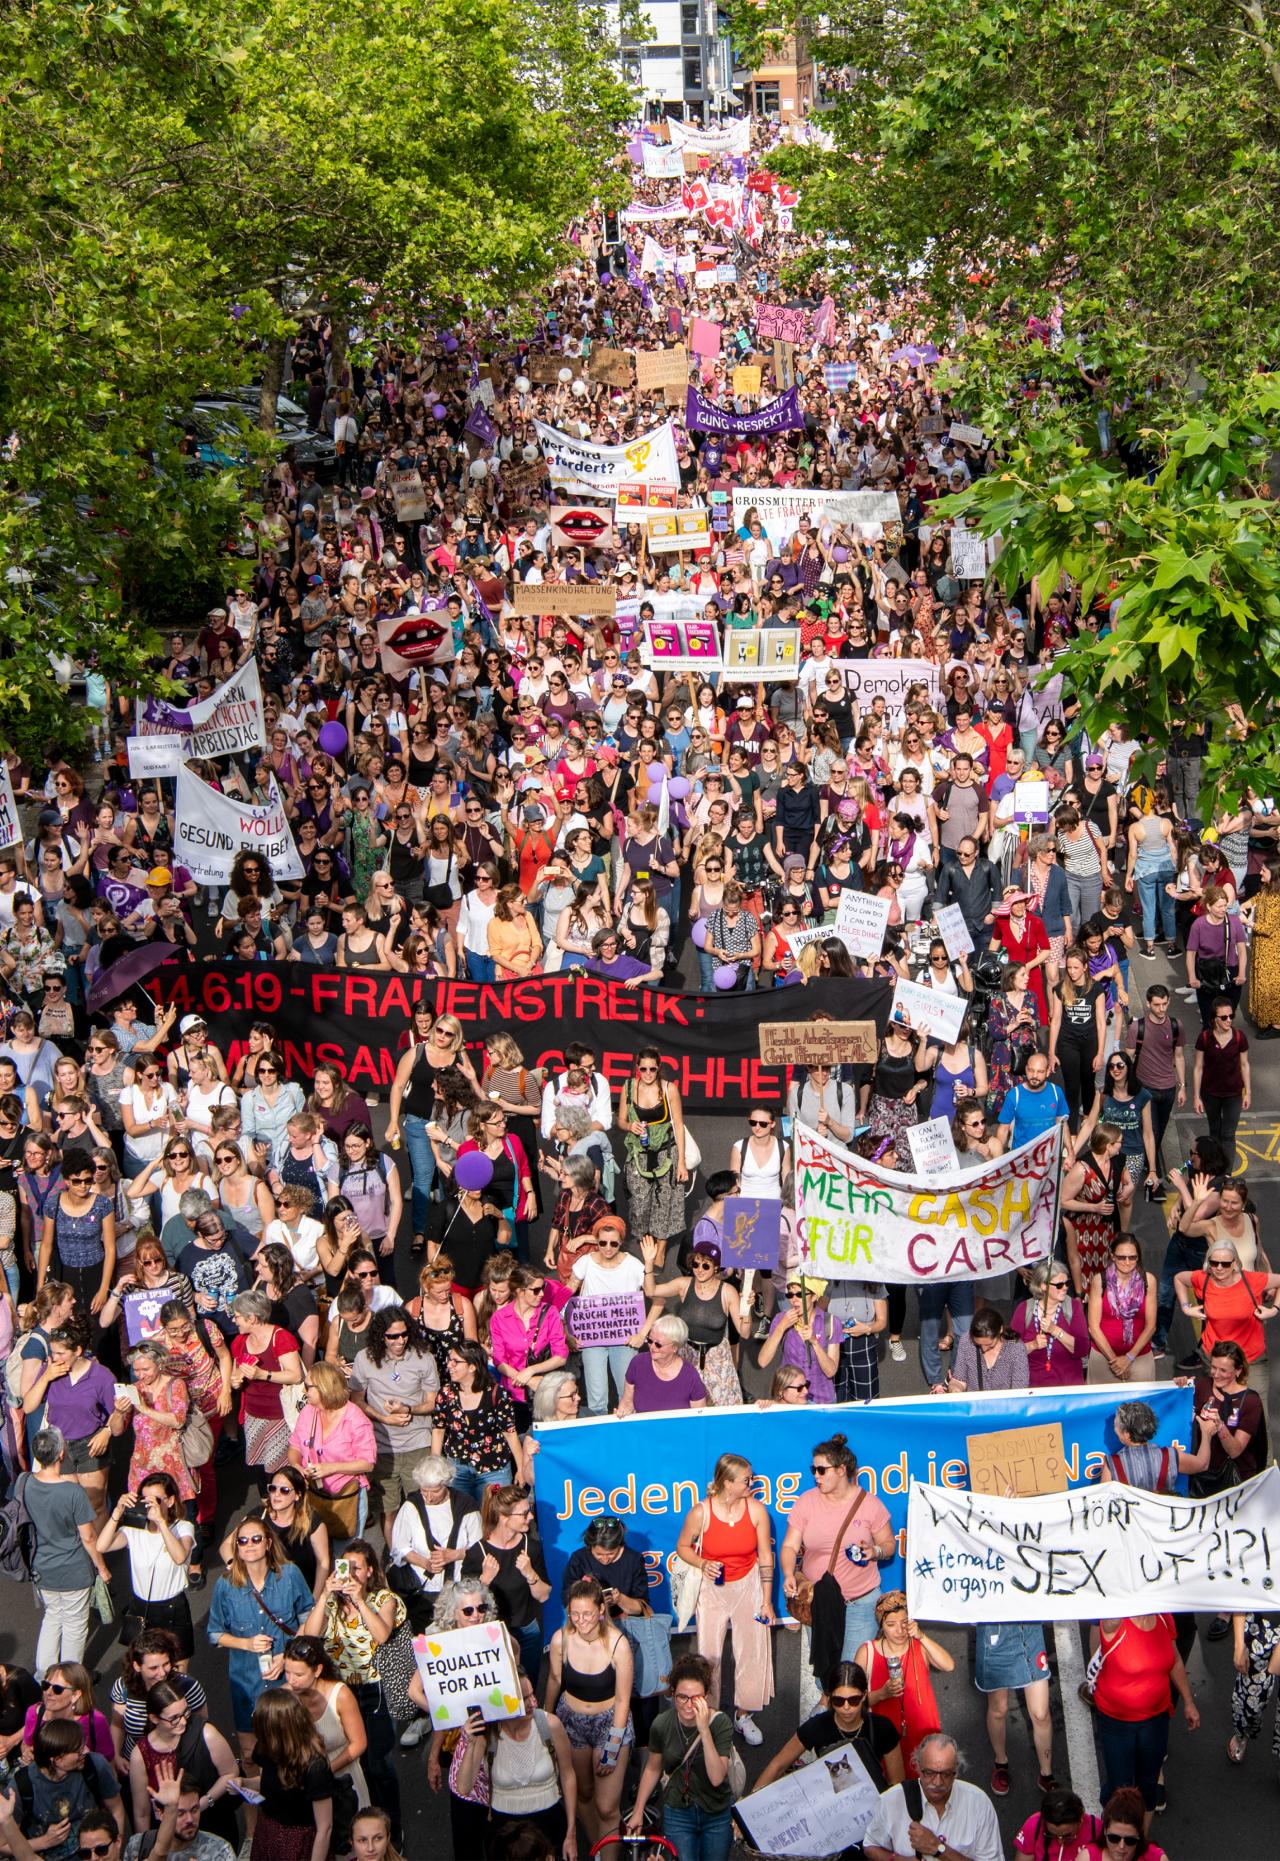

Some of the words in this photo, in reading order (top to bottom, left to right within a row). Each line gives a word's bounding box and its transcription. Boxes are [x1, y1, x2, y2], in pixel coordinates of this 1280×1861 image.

[696, 411, 730, 430] IGUNG
[736, 411, 784, 432] RESPEKT
[568, 447, 601, 461] wird
[516, 585, 612, 595] MASSENKINDHALTUNG
[845, 669, 941, 694] Demokrat
[193, 722, 258, 757] ARBEITSTAG
[180, 822, 234, 851] GESUND
[844, 893, 885, 909] ANYTHING
[849, 917, 865, 925] CAN
[866, 920, 878, 928] DO
[144, 971, 283, 1013] 14.6.19
[908, 1180, 1030, 1236] CASH
[806, 1216, 875, 1266] FÜR
[907, 1220, 1042, 1277] CARE
[572, 1296, 599, 1310] WEIL
[610, 1308, 640, 1320] MEHR
[556, 1472, 699, 1521] Jeden
[749, 1471, 802, 1514] ag
[853, 1450, 909, 1497] nd
[926, 1452, 967, 1491] je
[1010, 1544, 1108, 1598] SEX
[942, 1571, 1005, 1602] orgasm
[426, 1647, 501, 1677] EQUALITY
[438, 1677, 469, 1696] FOR
[473, 1671, 501, 1689] ALL
